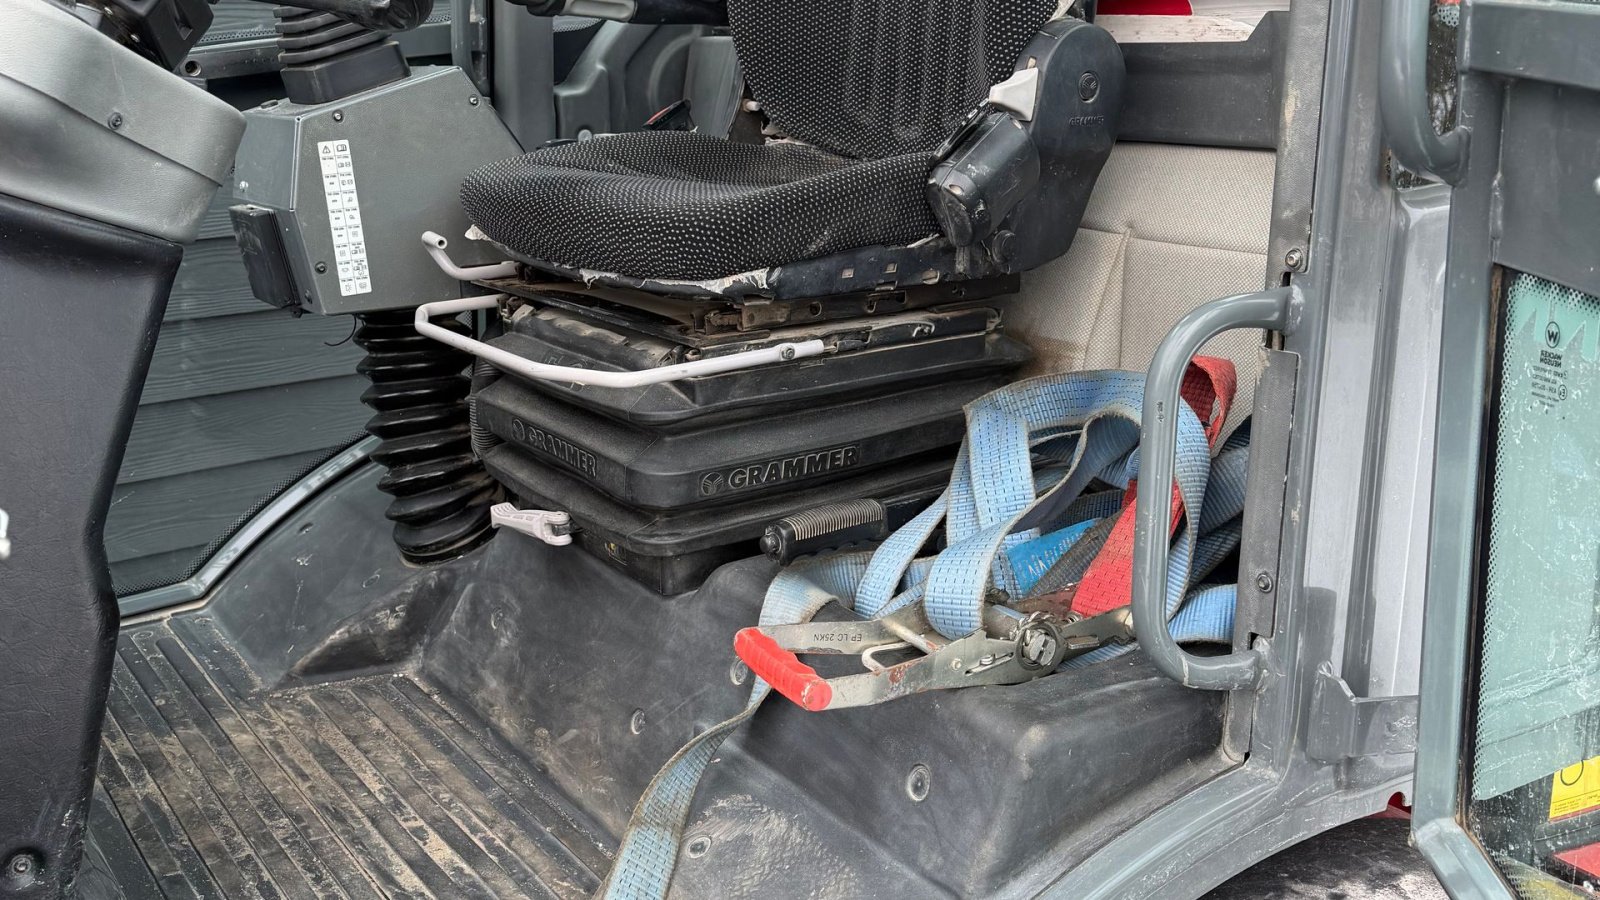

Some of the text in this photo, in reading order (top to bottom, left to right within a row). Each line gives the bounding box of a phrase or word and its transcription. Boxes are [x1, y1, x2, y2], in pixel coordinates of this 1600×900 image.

[528, 426, 597, 478] GRAMMER
[728, 445, 858, 489] GRAMMER
[813, 633, 863, 642] EP LC 25KN
